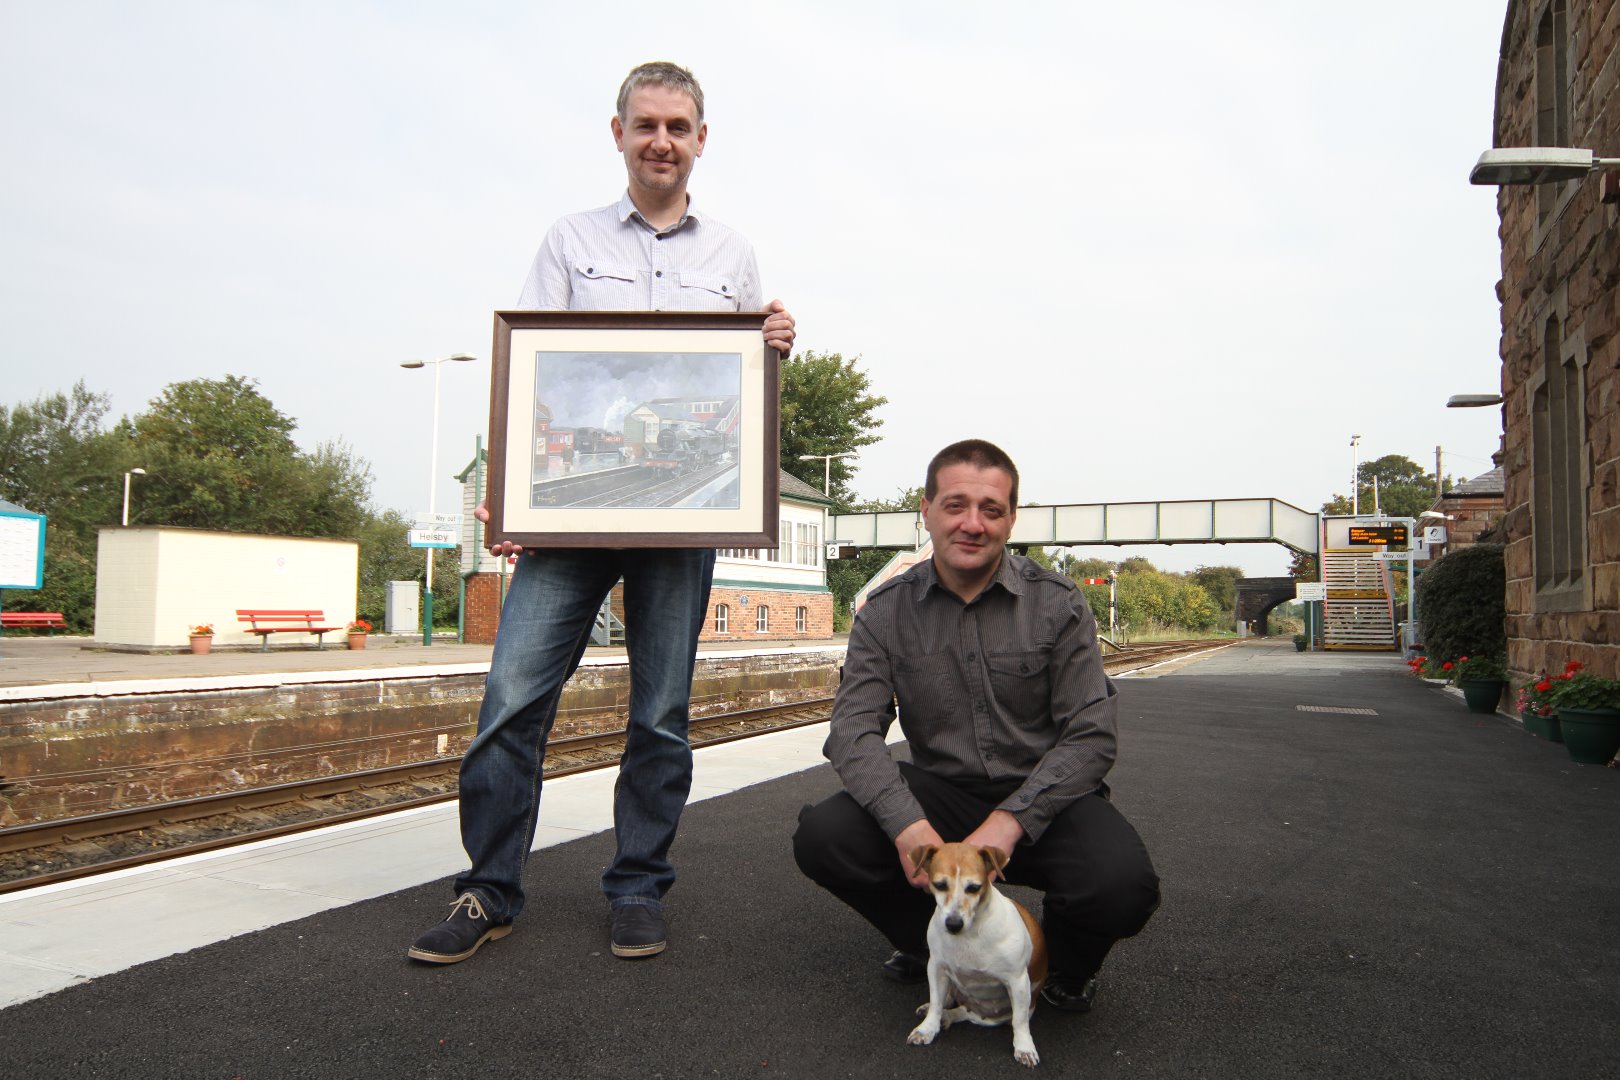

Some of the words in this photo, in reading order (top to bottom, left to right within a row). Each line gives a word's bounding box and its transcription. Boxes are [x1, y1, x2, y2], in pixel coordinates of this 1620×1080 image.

[435, 514, 446, 522] Way
[447, 514, 456, 522] out
[419, 532, 448, 542] Helsby
[1417, 539, 1423, 550] 1
[829, 547, 836, 557] 2
